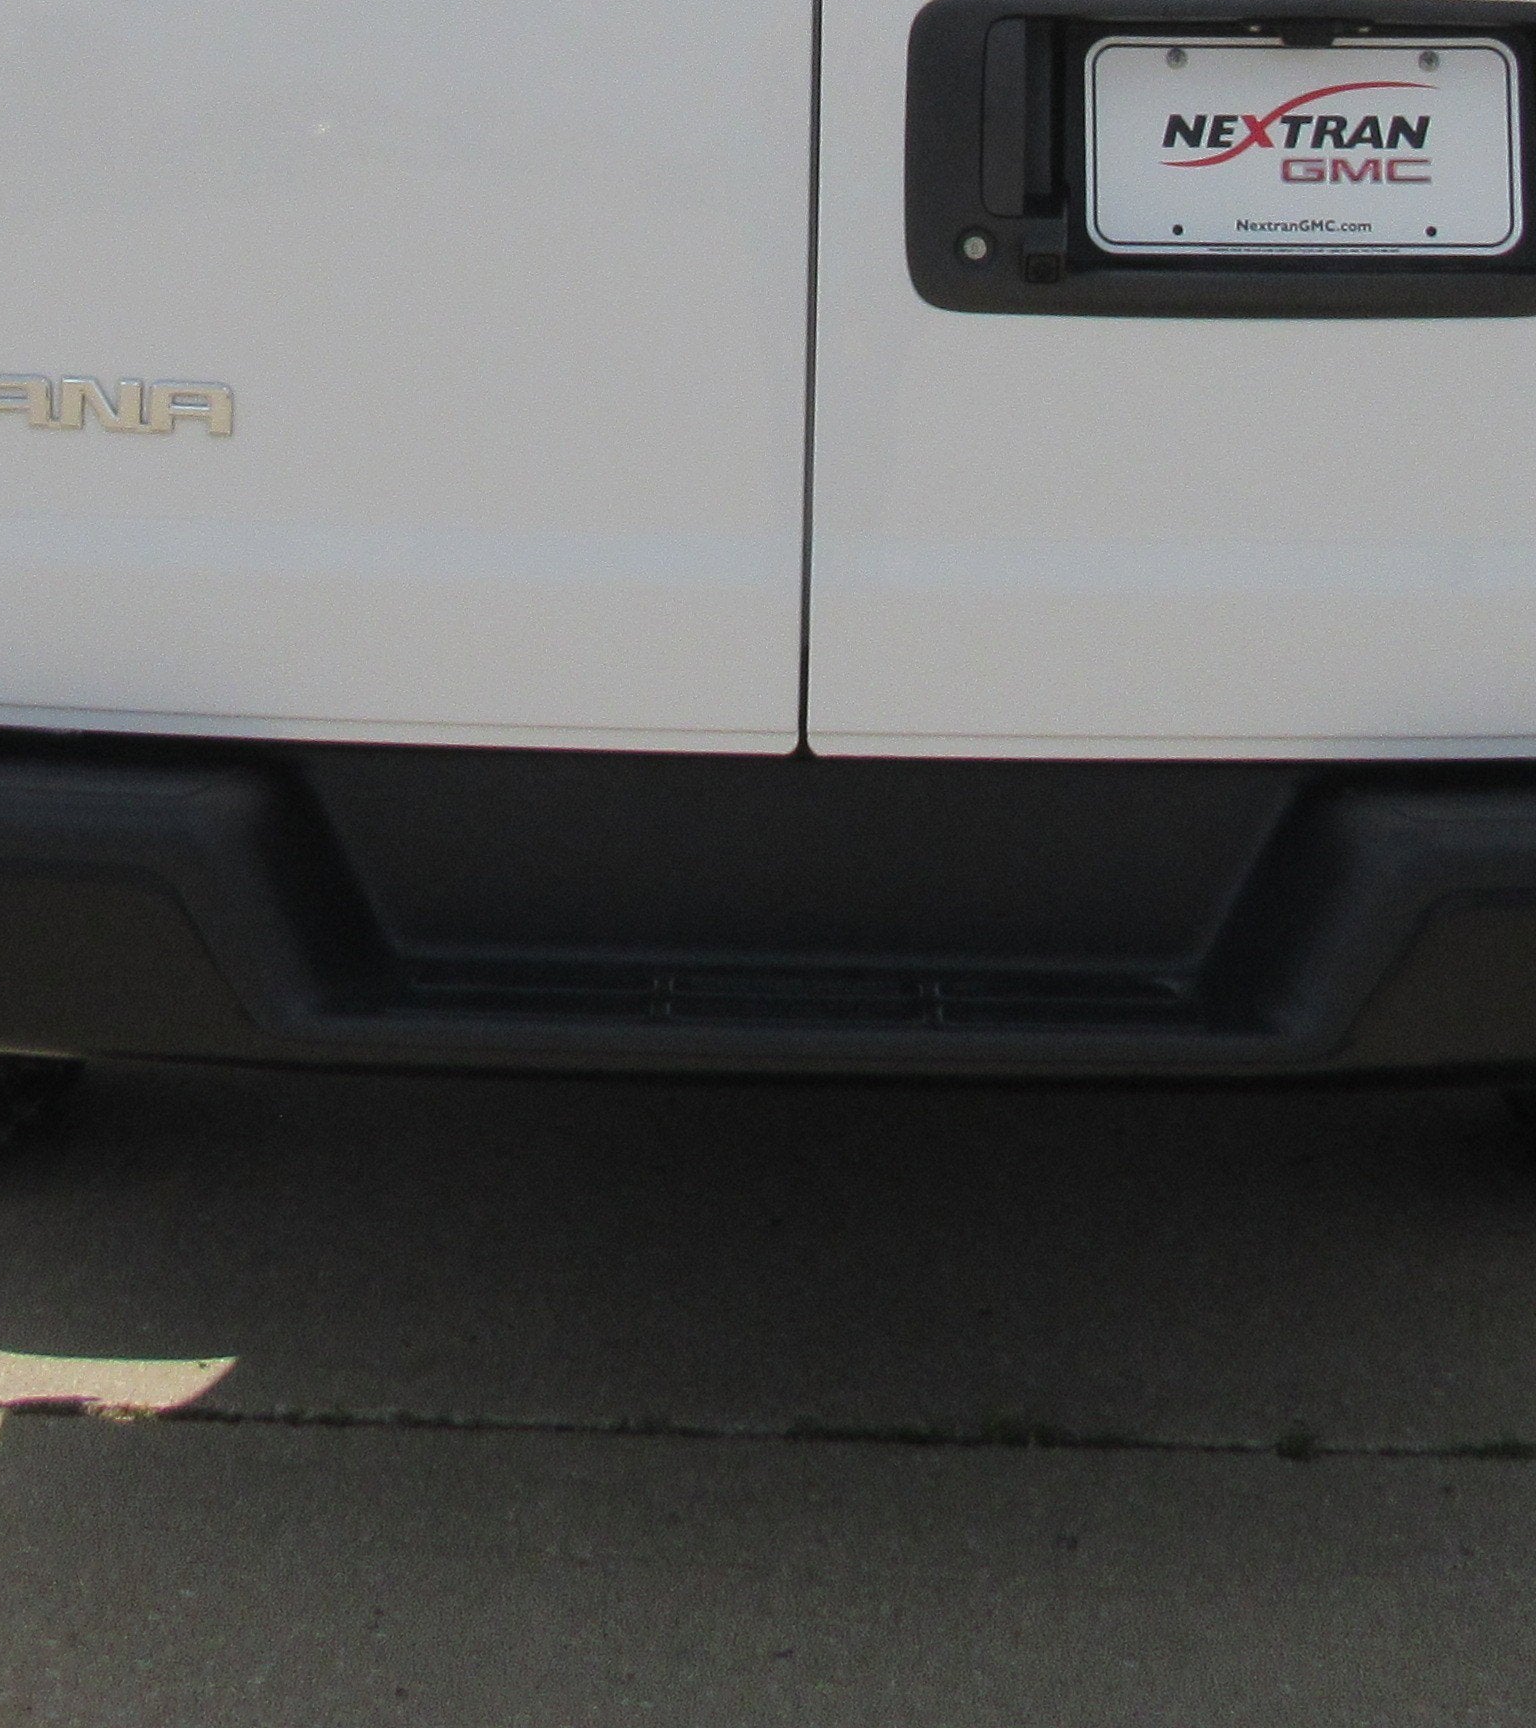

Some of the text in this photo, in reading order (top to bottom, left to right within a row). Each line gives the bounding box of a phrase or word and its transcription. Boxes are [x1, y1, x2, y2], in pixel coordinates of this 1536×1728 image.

[1162, 114, 1430, 149] NEXTRAN
[1281, 158, 1431, 184] GMC
[1236, 219, 1372, 232] NextranGMC.com
